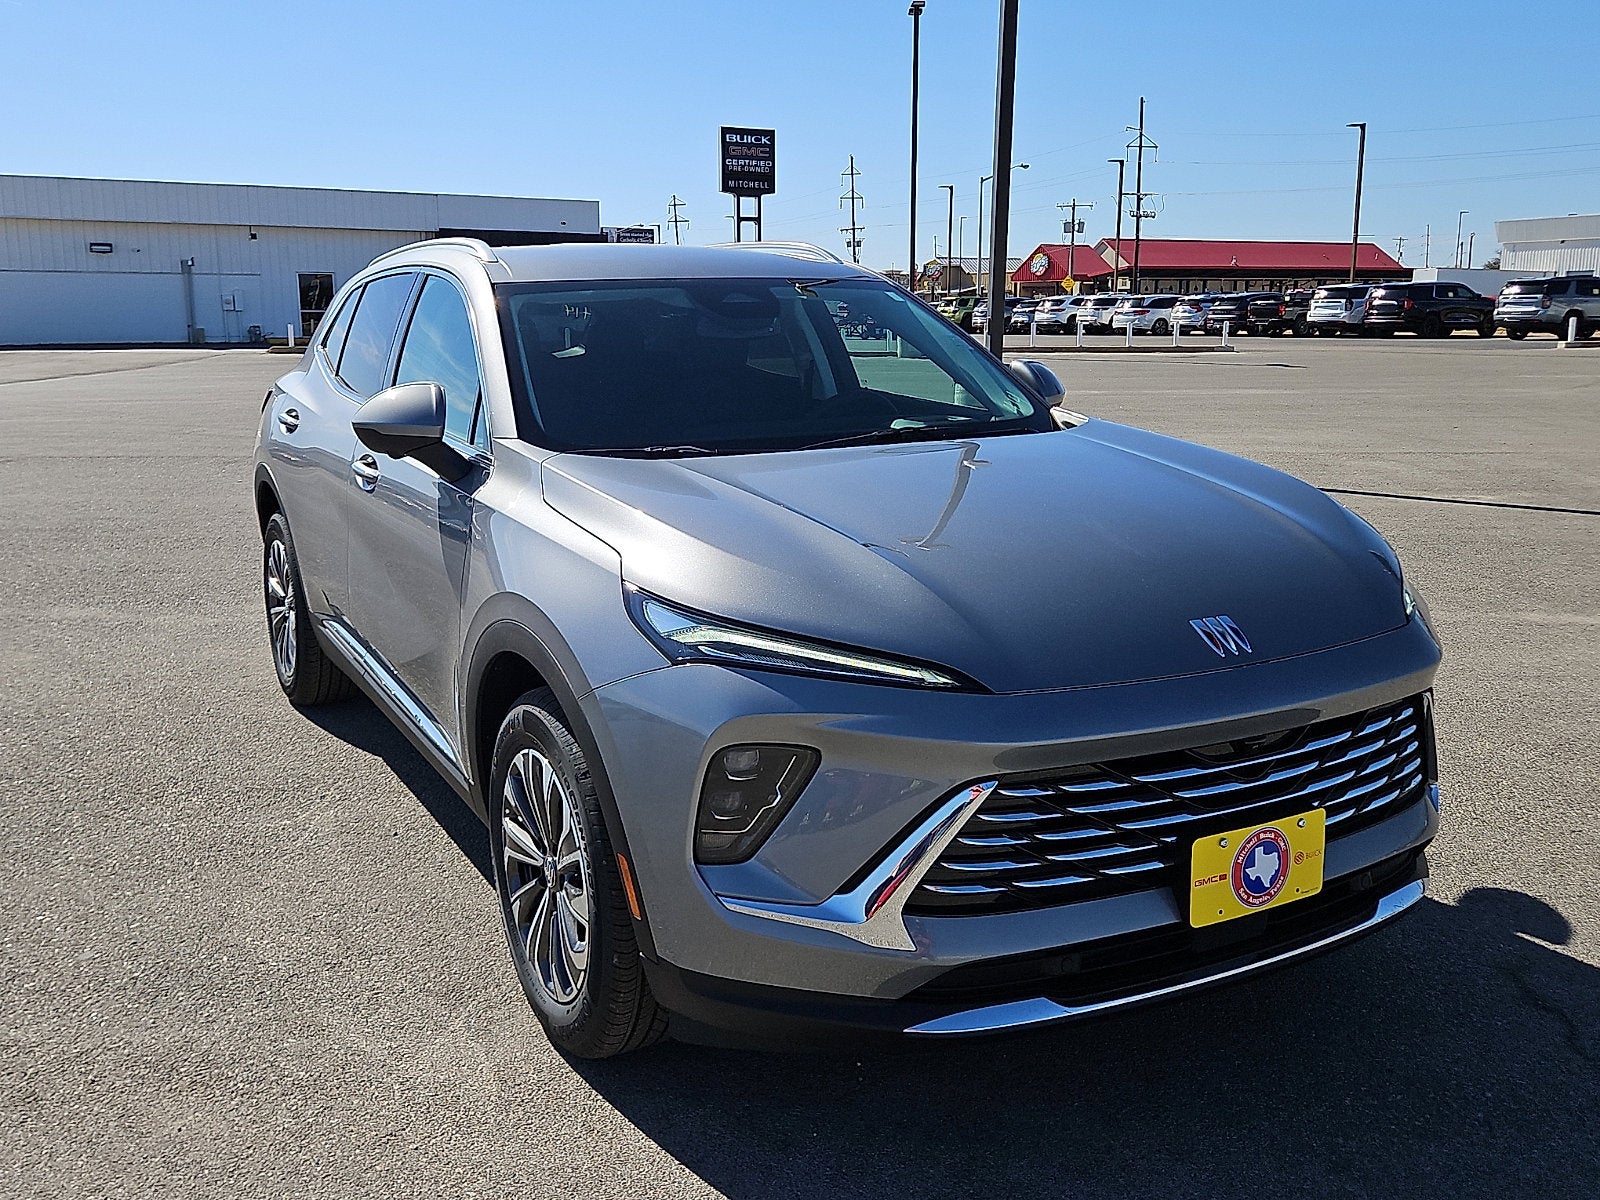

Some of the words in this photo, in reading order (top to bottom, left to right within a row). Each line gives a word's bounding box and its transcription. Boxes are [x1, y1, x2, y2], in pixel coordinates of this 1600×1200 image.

[725, 133, 771, 145] BUICK
[728, 145, 770, 157] GMC
[725, 158, 773, 167] CERTIFIED
[728, 165, 770, 173] PRE-OWNED
[728, 180, 770, 189] MITCHELL
[1236, 836, 1258, 864] Mitchell
[1259, 831, 1275, 840] Buick
[1194, 875, 1219, 888] GMC
[1238, 887, 1248, 900] San
[1269, 875, 1285, 896] Texas
